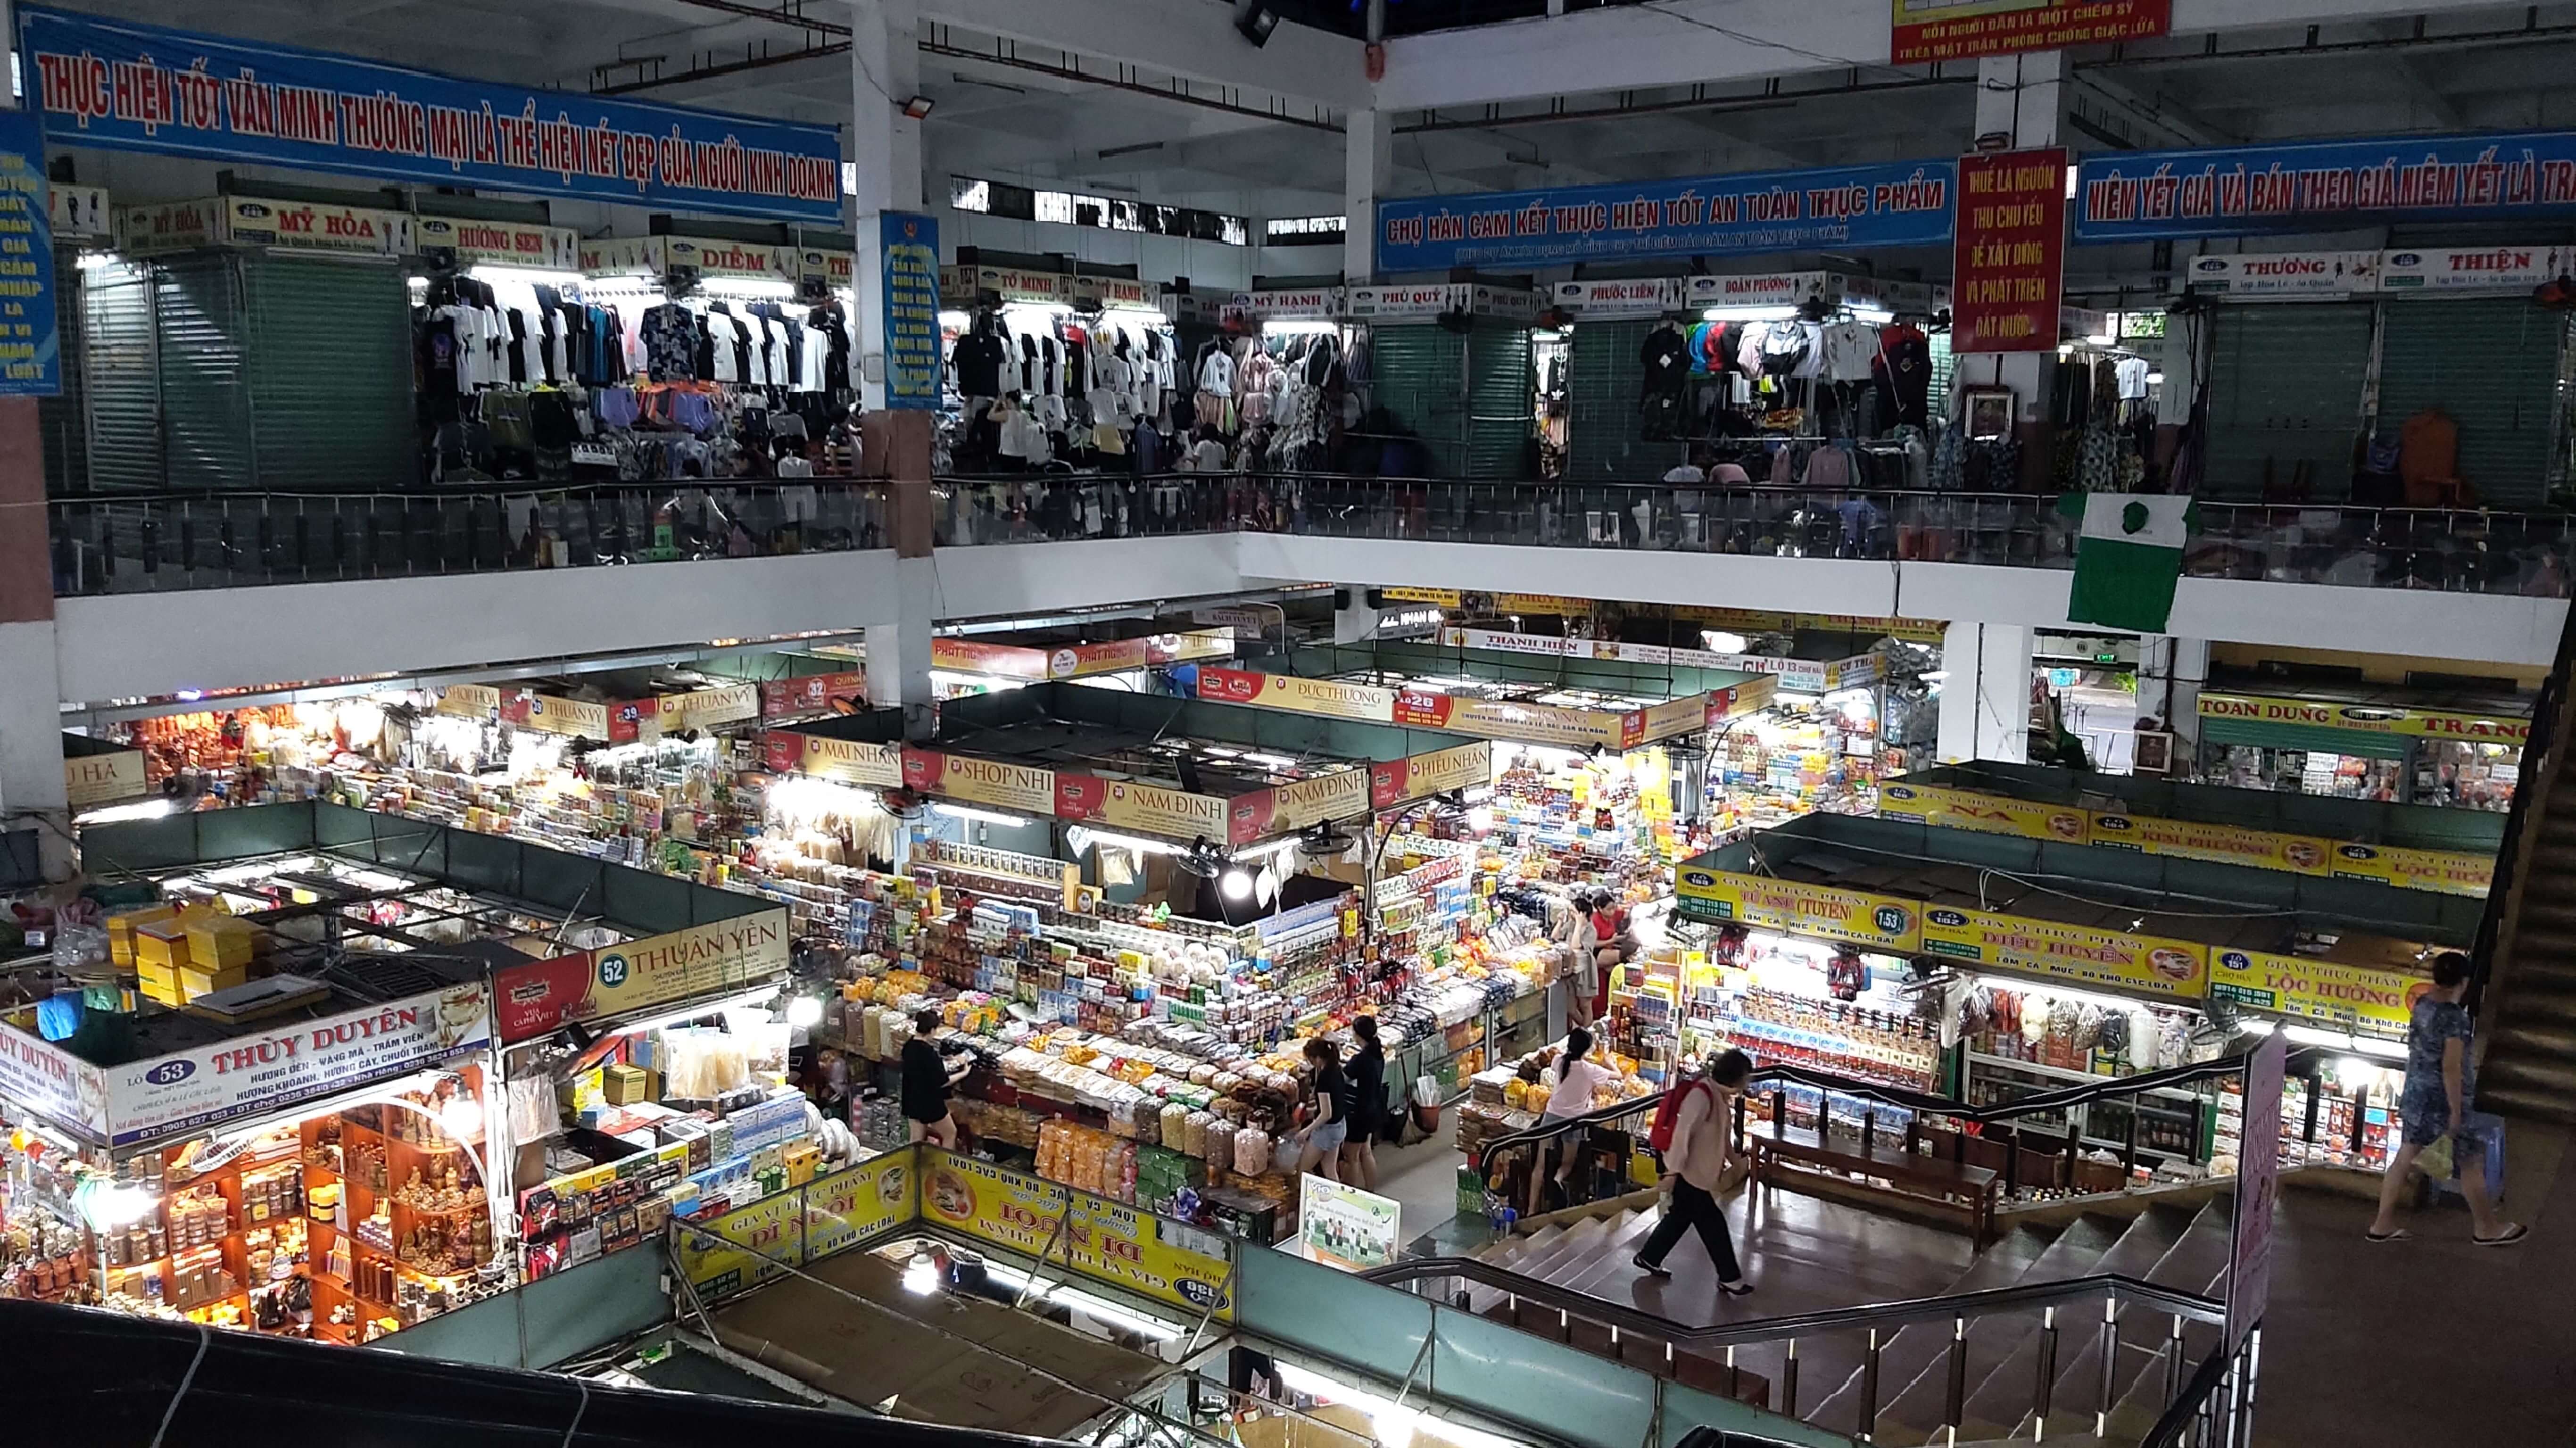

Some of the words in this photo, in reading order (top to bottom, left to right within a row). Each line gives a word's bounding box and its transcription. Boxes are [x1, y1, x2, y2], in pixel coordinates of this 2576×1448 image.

[35, 50, 109, 129] THỰC
[112, 52, 174, 136] HIỆN
[175, 56, 222, 131] TỐT
[227, 67, 276, 137] VĂN
[277, 85, 338, 145] MINH
[340, 89, 426, 157] THƯƠNG
[430, 105, 469, 171] MẠI
[471, 99, 497, 164] LÀ
[497, 97, 537, 169] THỂ
[538, 111, 584, 184] HIỆN
[585, 116, 620, 178] NÉT
[622, 134, 656, 191] ĐẸP
[659, 123, 694, 188] CỦA
[696, 133, 746, 193] NGƯỜI
[748, 147, 785, 196] KINH
[786, 152, 837, 201] DOANH
[1969, 163, 1994, 193] THUẾ
[1998, 164, 2012, 192] LÀ
[2016, 159, 2055, 191] NGUỒN
[2086, 169, 2137, 222] NIÊM
[2140, 162, 2179, 220] YẾT
[2181, 164, 2214, 217] GIÁ
[2220, 162, 2245, 216] VÀ
[2249, 162, 2296, 216] BÁN
[2299, 166, 2353, 212] THEO
[2357, 157, 2395, 210] GIÁ
[2396, 153, 2453, 208] NIÊM
[2459, 146, 2508, 207] YẾT
[2507, 148, 2534, 204] LÀ
[1387, 214, 1424, 246] CHỢ
[1428, 207, 1465, 241] HÀN
[1469, 212, 1510, 238] CAM
[1516, 199, 1550, 236] KẾT
[1556, 198, 1607, 234] THỰC
[1612, 194, 1659, 237] HIỆN
[1665, 187, 1706, 226] TỐT
[1708, 193, 1738, 223] AN
[1745, 186, 1800, 222] TOÀN
[1808, 181, 1868, 222] THỰC
[1874, 167, 1946, 214] PHẨM
[1973, 207, 1994, 229] THU
[1997, 195, 2021, 228] CHỦ
[2023, 195, 2044, 225] YẾU
[278, 206, 317, 233] MỸ
[324, 210, 376, 237] HÒA
[514, 233, 543, 253] SEN
[1988, 237, 2011, 267] XÂY
[2243, 257, 2325, 275] THƯƠNG
[2449, 251, 2531, 273] THIỆN
[1021, 276, 1052, 293] MINH
[1280, 295, 1321, 310] HẠNH
[1487, 635, 1539, 647] THANH
[1787, 662, 1797, 672] 13
[1412, 695, 1434, 707] 26
[622, 706, 638, 720] 39
[2268, 706, 2329, 723] DUNG
[826, 743, 850, 760] MAI
[964, 757, 1011, 786] SHOP
[1015, 764, 1053, 793] NHI
[1133, 789, 1171, 811] NAM
[1292, 782, 1325, 804] NAM
[730, 919, 778, 950] YẾN
[603, 960, 623, 983] 52
[2228, 960, 2243, 969] 151
[2265, 959, 2290, 971] GIA
[2265, 972, 2309, 993] LỘC
[2375, 1018, 2392, 1028] Khô
[211, 1034, 305, 1075] THÙY
[311, 1006, 420, 1051] DUYÊN
[127, 1074, 144, 1087] LÔ
[159, 1063, 185, 1082] 53
[250, 1067, 287, 1084] HƯƠNG
[162, 1120, 186, 1133] 0905
[237, 1102, 252, 1113] ĐT
[278, 1091, 301, 1103] 0236
[354, 1070, 373, 1083] Nhà
[374, 1064, 402, 1080] riêng:
[236, 1084, 274, 1101] HƯƠNG
[975, 1165, 997, 1179] CÁC
[1000, 1173, 1022, 1190] KHÔ
[1085, 1200, 1101, 1212] CÁ
[1111, 1208, 1139, 1224] TÔM
[730, 1211, 762, 1232] GIA
[748, 1218, 783, 1250] DÌ
[841, 1227, 857, 1244] KHÔ
[859, 1222, 875, 1236] CÁC
[979, 1218, 1035, 1247] PHẨM
[1100, 1233, 1145, 1264] DÌ
[1130, 1270, 1168, 1289] GIA
